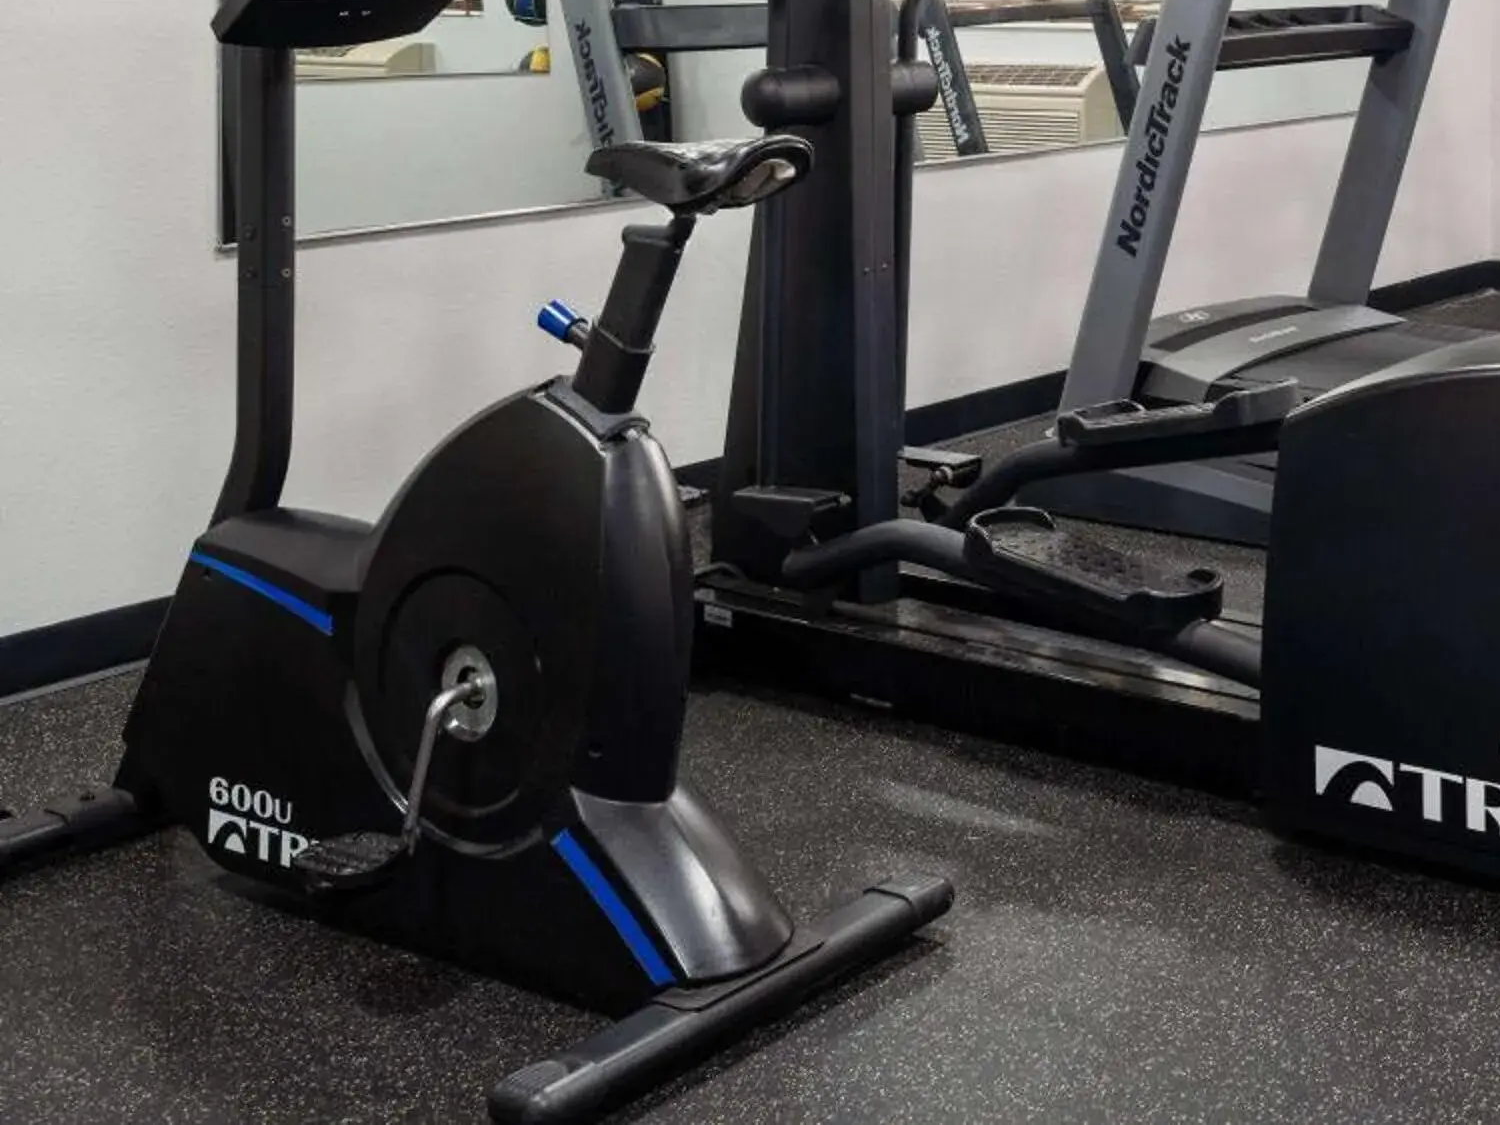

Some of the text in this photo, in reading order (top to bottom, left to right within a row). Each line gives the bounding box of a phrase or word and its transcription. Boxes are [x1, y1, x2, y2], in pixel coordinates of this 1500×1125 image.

[1116, 34, 1192, 259] NordicTrack
[209, 776, 293, 825] 600U
[248, 820, 320, 869] TR
